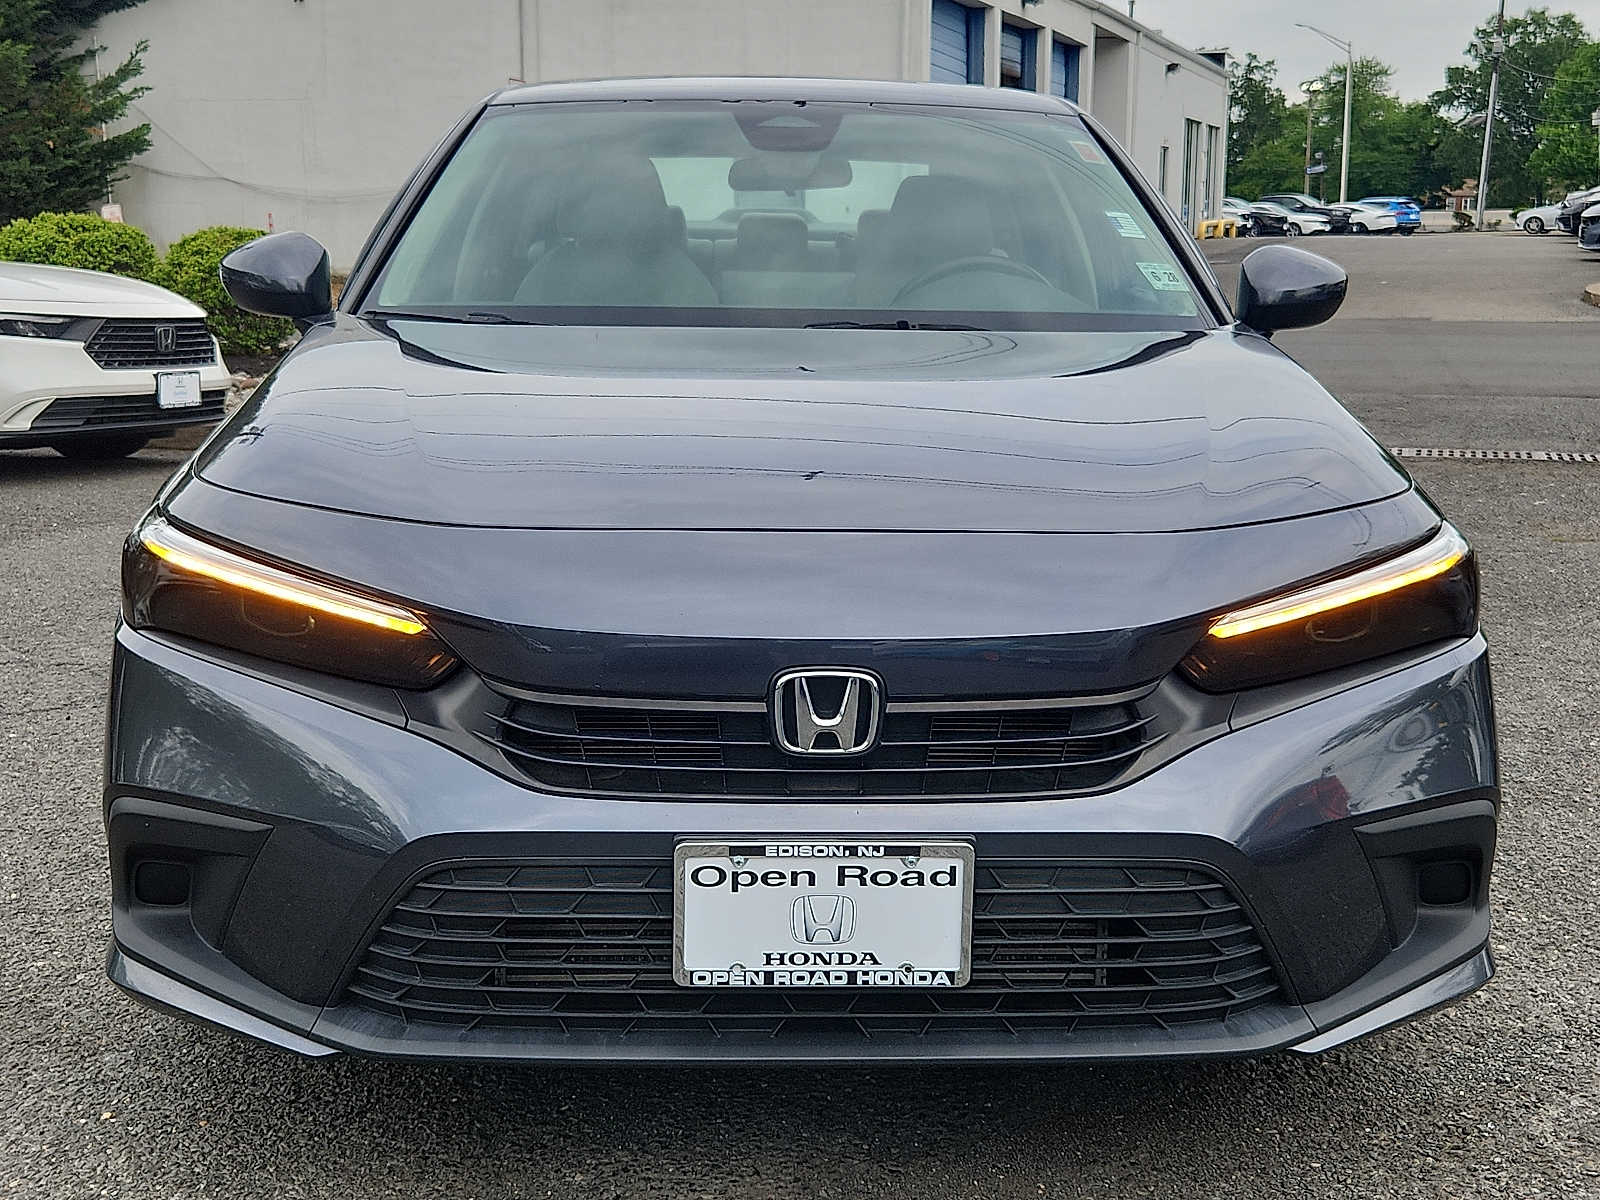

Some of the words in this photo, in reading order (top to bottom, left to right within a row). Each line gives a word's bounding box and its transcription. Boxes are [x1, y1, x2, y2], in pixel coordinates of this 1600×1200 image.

[765, 846, 851, 857] EDISON,
[857, 846, 885, 857] NJ
[690, 865, 816, 893] Open
[837, 865, 957, 887] Road
[762, 951, 882, 966] HONDA
[692, 971, 764, 985] OPEN
[773, 971, 848, 985] ROAD
[856, 971, 952, 986] HONDA
